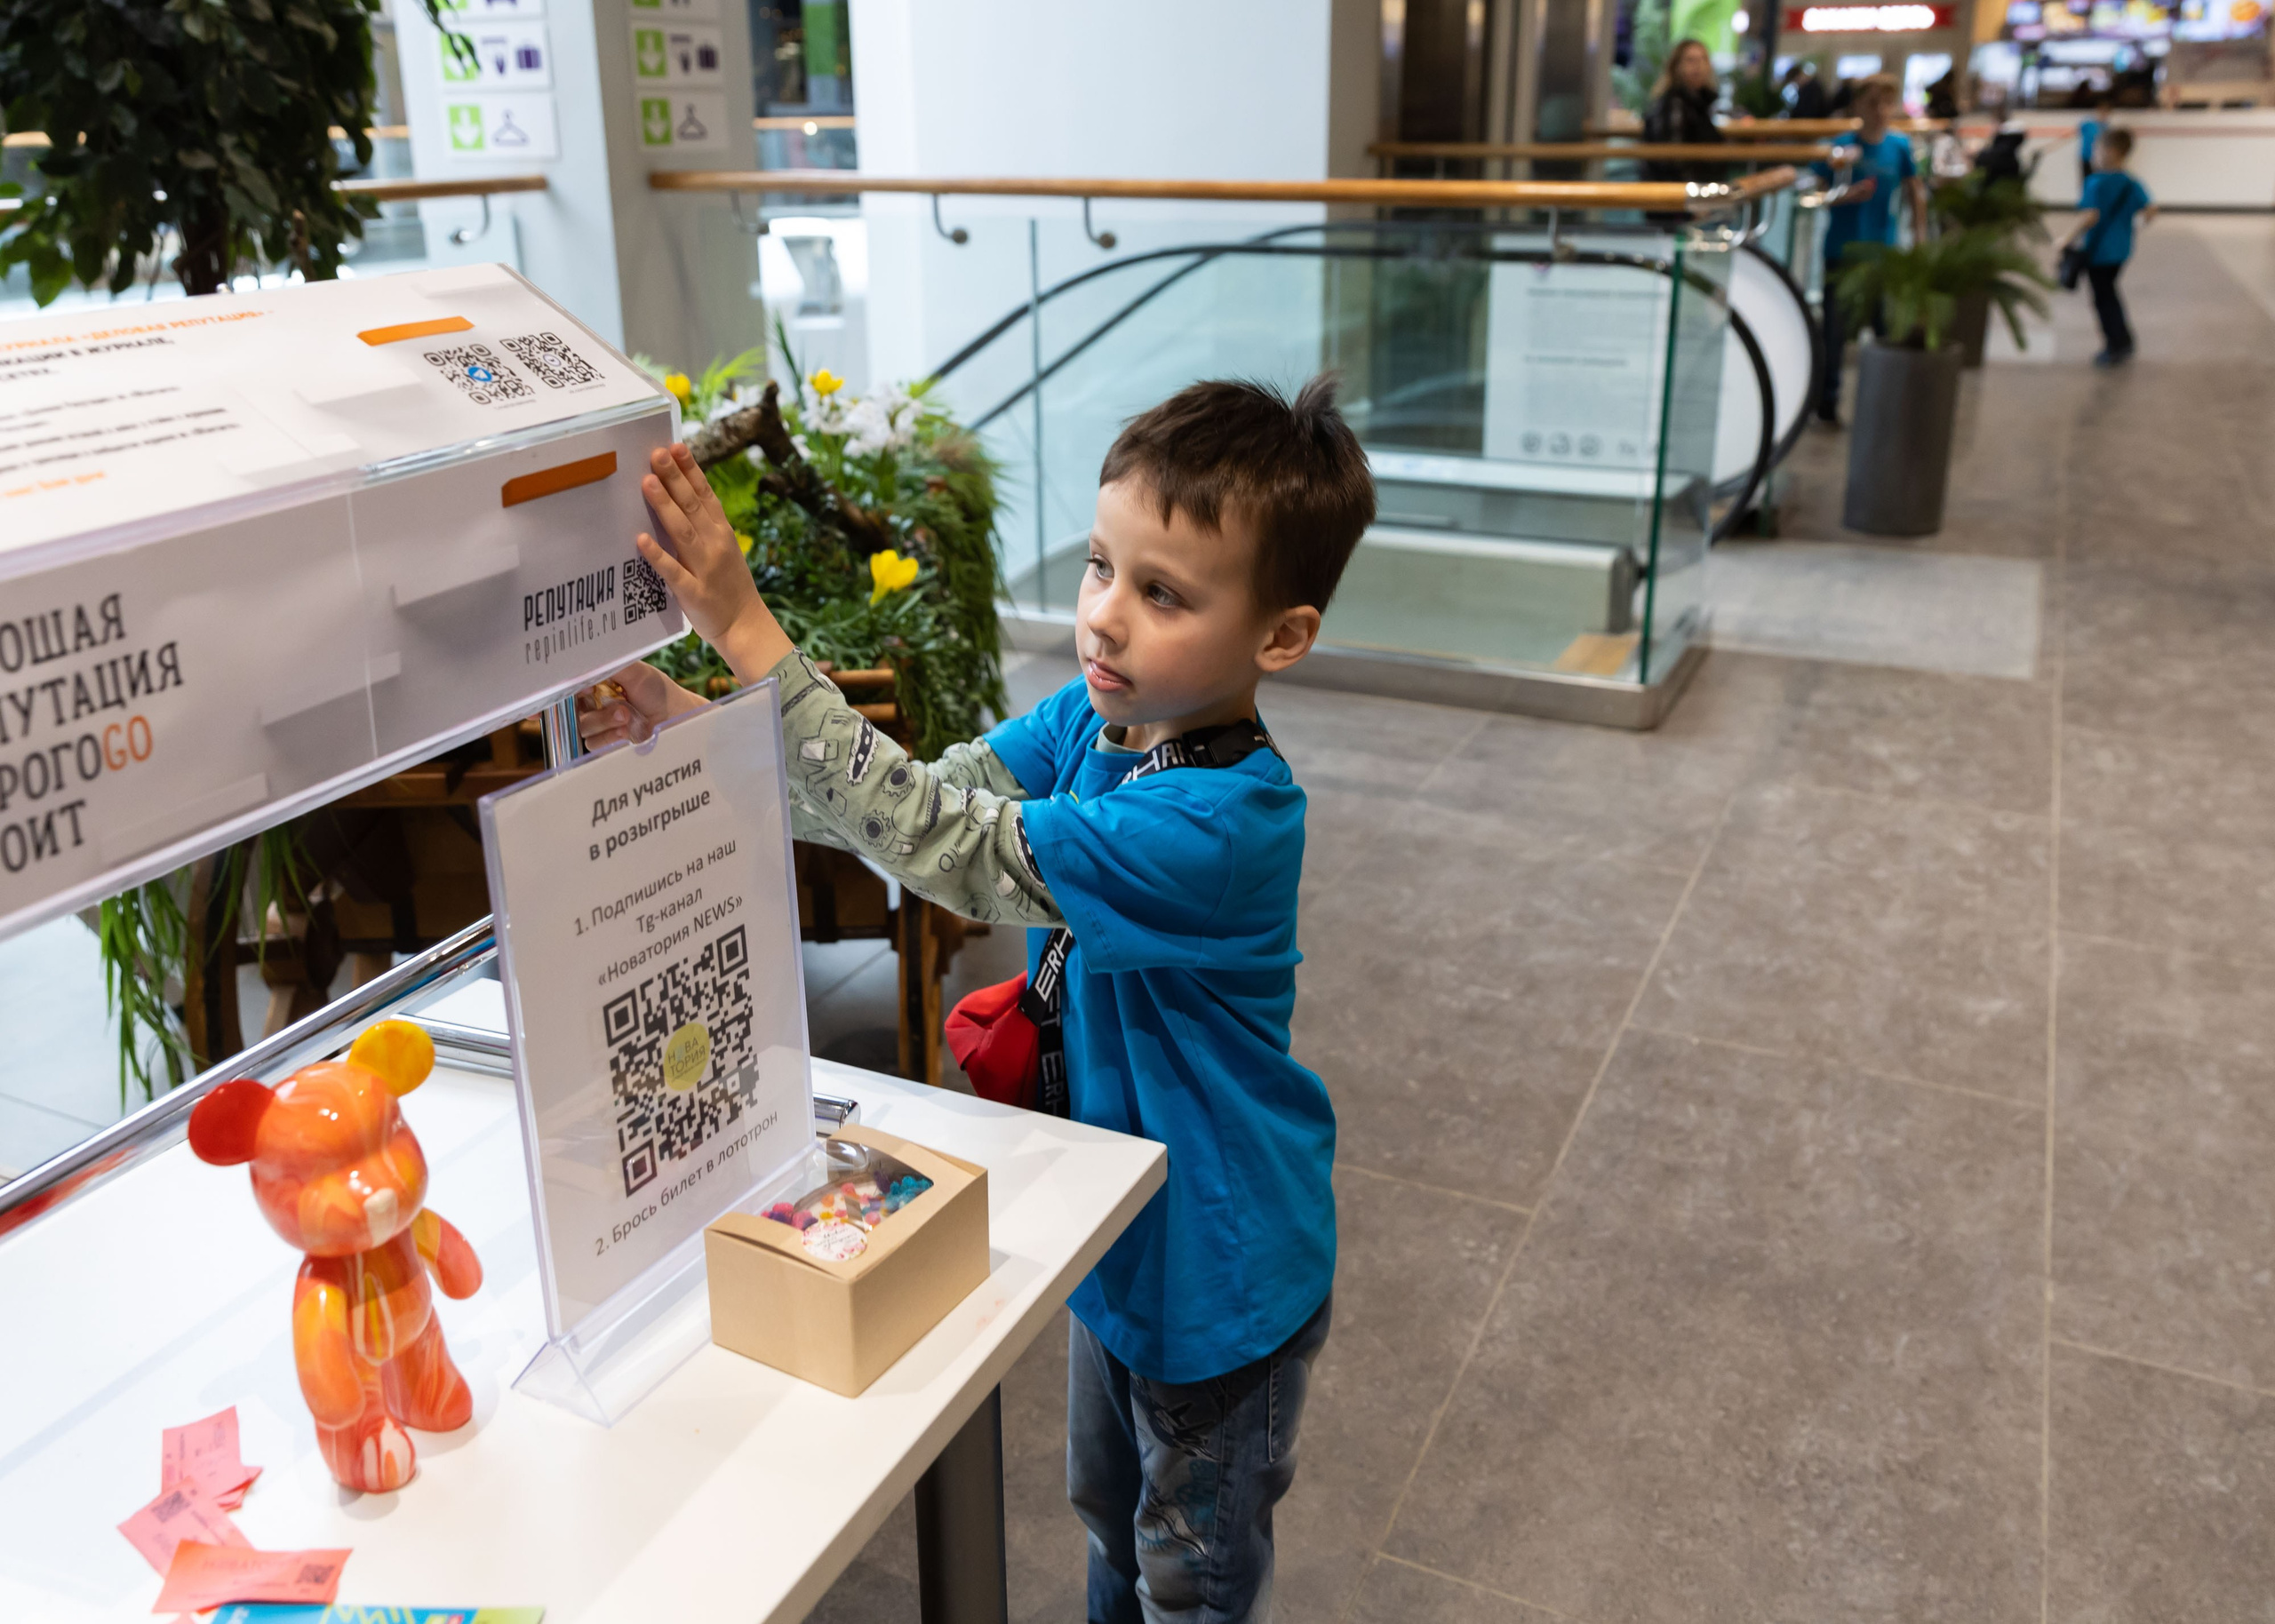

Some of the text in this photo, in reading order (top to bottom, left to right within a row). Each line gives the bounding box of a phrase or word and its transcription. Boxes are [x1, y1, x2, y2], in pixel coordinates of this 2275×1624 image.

[0, 593, 127, 673] ОШАЯ
[524, 566, 615, 632] РЕПУТАЦИЯ
[525, 610, 617, 665] repinlife.ru
[589, 790, 710, 861] в розыгрыше
[592, 758, 702, 827] Для участия
[1, 800, 87, 873] ОИТ
[574, 840, 736, 935] 1. Подпишись на наш
[635, 888, 703, 934] Tg-канал
[598, 896, 743, 985] «Новатория NEWS»
[670, 1045, 706, 1077] ТОРИЯ
[595, 1111, 778, 1256] 2. Брось билет в лототрон
